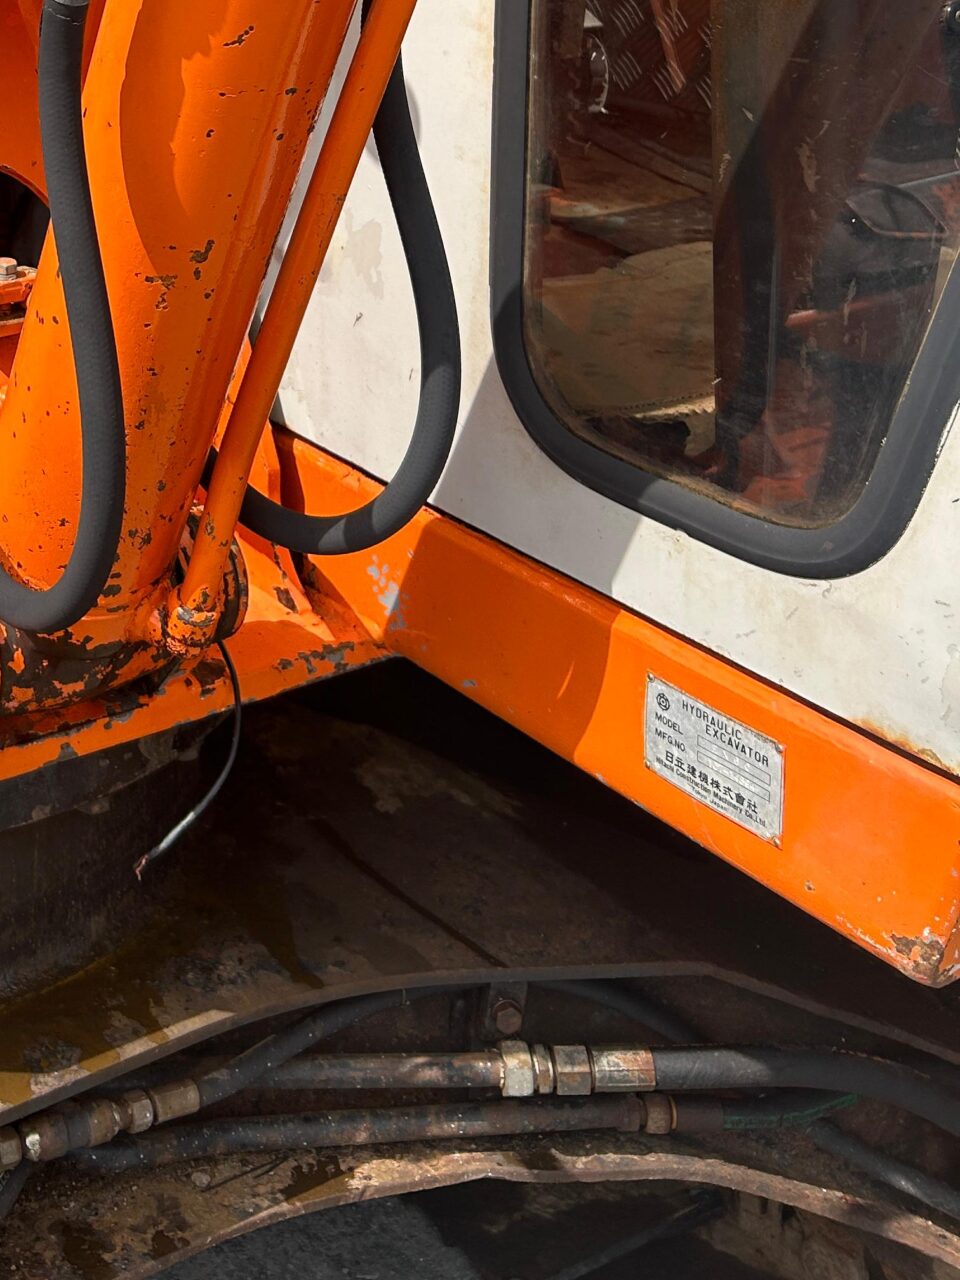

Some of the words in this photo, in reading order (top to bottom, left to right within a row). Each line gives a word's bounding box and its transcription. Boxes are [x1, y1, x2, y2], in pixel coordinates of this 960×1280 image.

[655, 712, 684, 735] MODEL
[682, 700, 743, 740] HYDRAULIC
[705, 724, 770, 767] EXCAVATOR
[713, 790, 743, 814] Machinery
